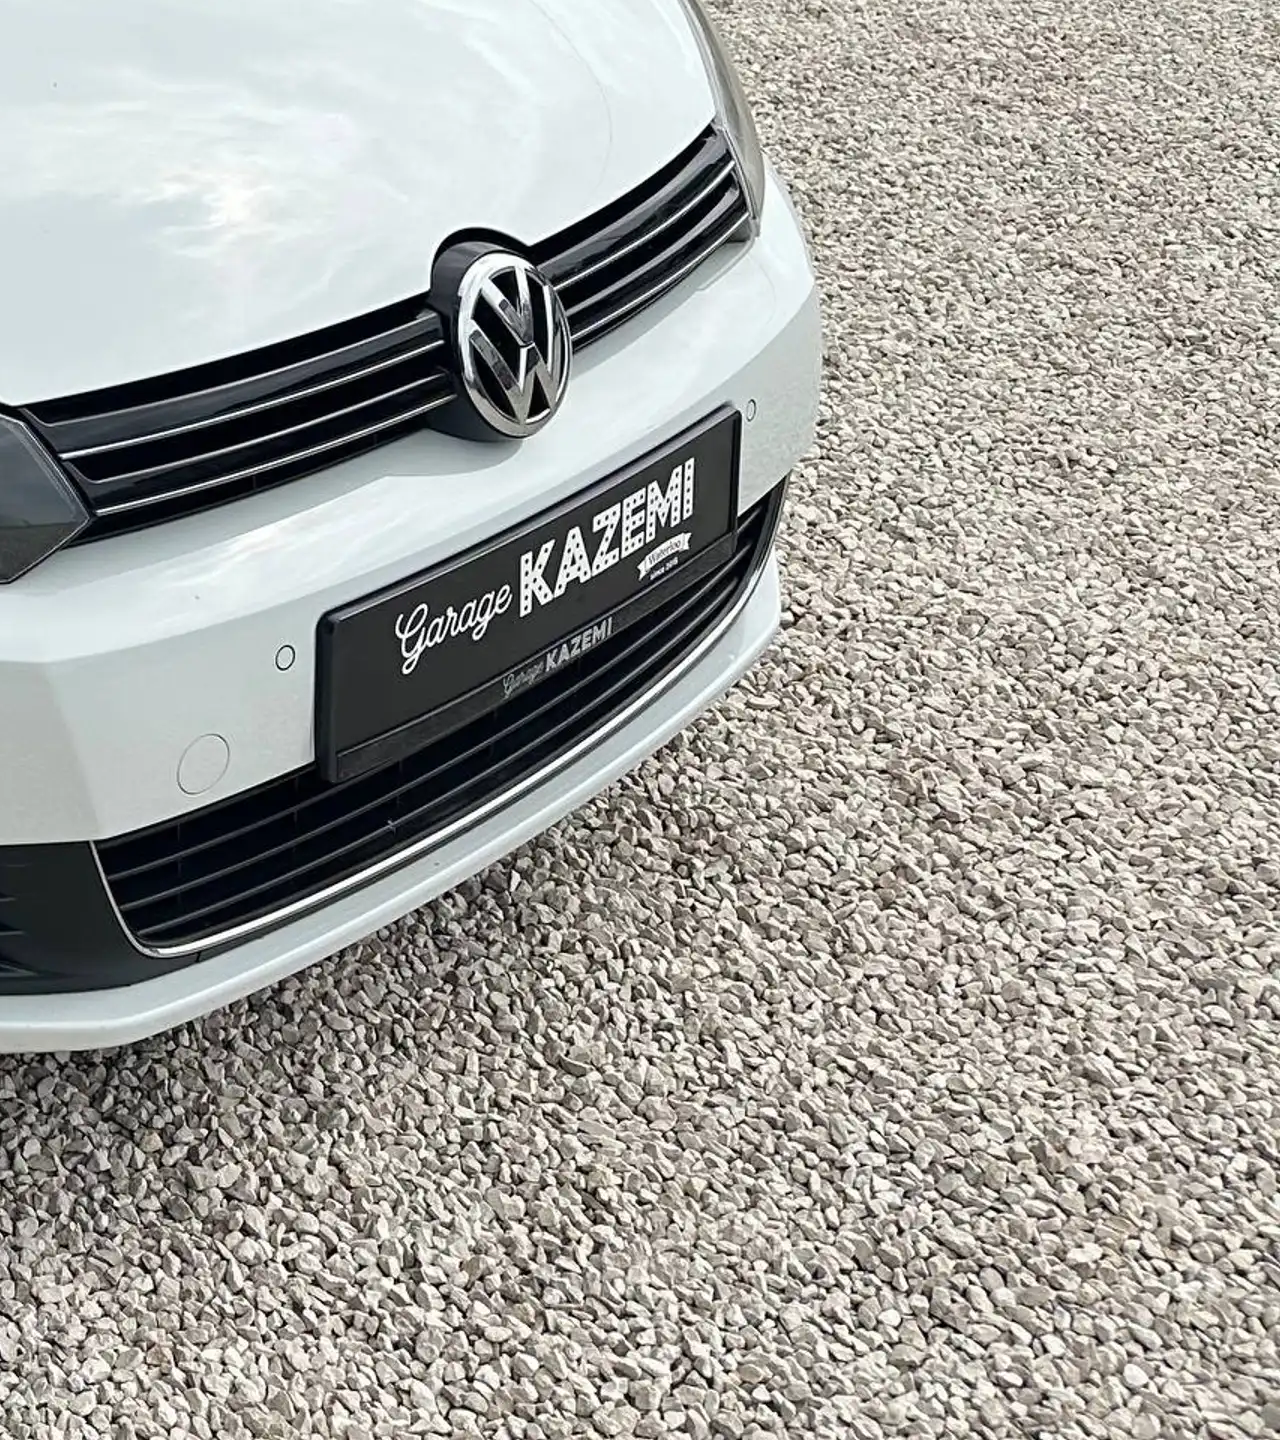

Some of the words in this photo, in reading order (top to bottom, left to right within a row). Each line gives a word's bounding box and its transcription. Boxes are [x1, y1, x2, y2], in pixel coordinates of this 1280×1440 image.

[395, 583, 513, 675] Garage
[519, 457, 695, 617] KAZEMI
[545, 617, 614, 672] KAZEMI
